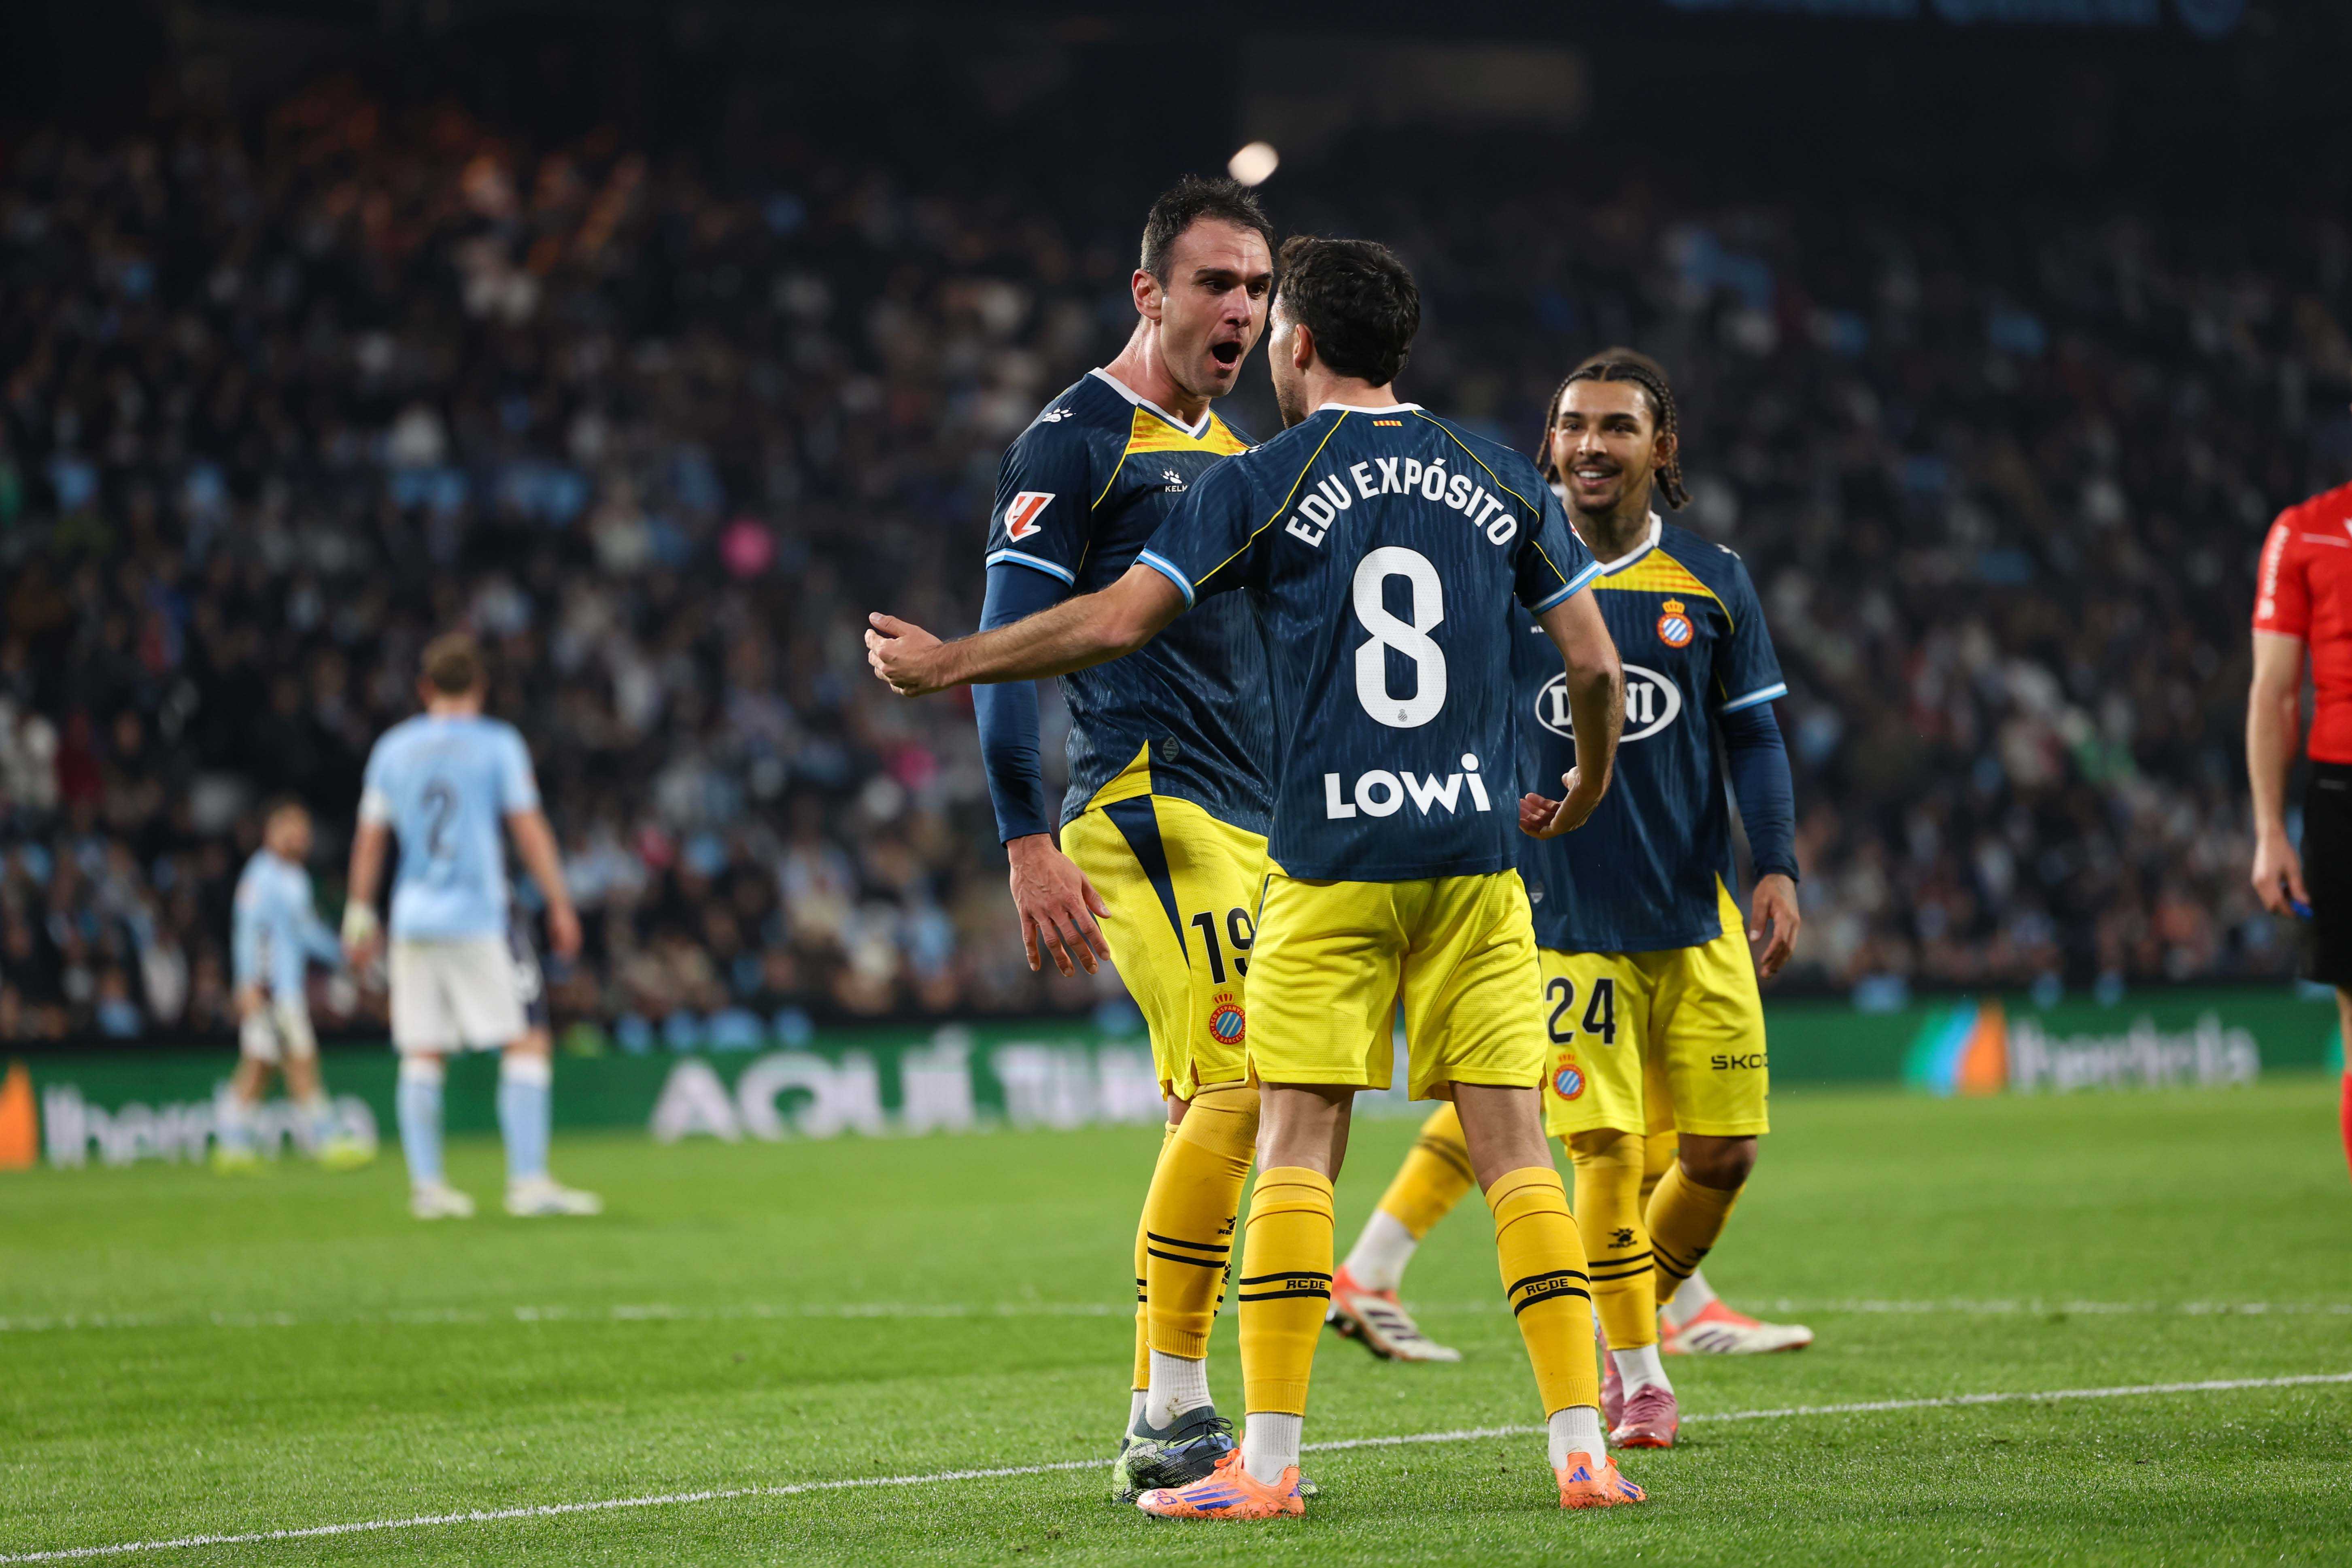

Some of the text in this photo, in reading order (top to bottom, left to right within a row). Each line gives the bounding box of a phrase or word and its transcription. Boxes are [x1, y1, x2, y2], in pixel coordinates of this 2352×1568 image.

[1285, 457, 1517, 548] EDU EXPÓSITO
[1353, 546, 1447, 728] 8
[1190, 907, 1256, 985] 19
[1546, 977, 1616, 1045] 24
[1285, 1280, 1326, 1289] RCDE
[1525, 1278, 1568, 1296] RCDE
